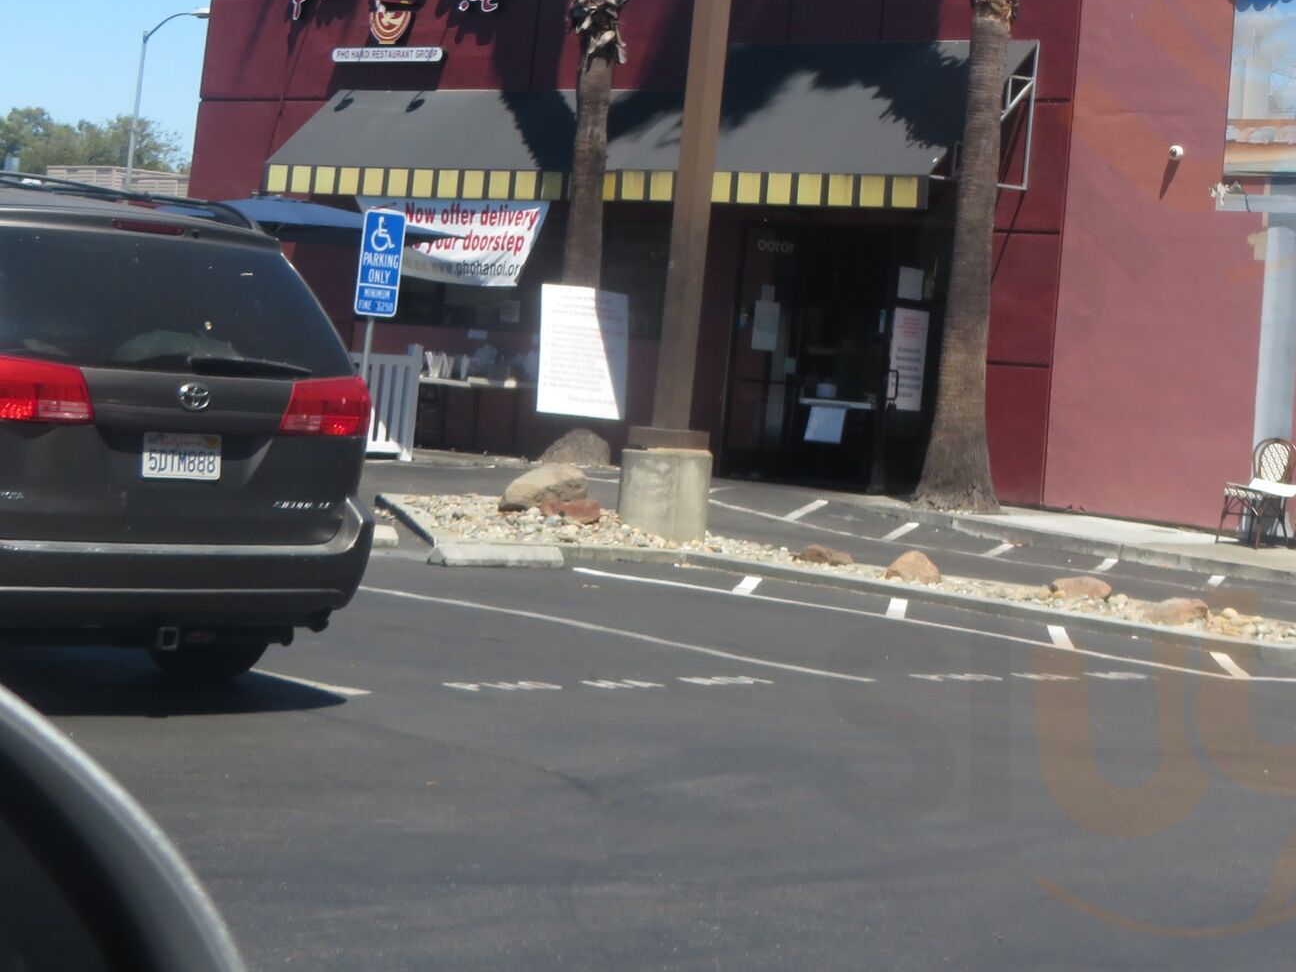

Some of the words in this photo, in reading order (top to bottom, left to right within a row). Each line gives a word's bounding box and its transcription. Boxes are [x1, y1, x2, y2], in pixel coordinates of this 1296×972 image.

[372, 49, 414, 59] RESTAURANT
[405, 202, 435, 223] Now
[441, 202, 476, 226] offer
[480, 203, 539, 231] delivery
[463, 229, 525, 257] doorstep
[363, 252, 399, 269] PARKING
[368, 269, 391, 284] ONLY
[363, 288, 391, 300] MINIMUM
[359, 299, 372, 311] FINE
[149, 449, 216, 473] 5DTM888
